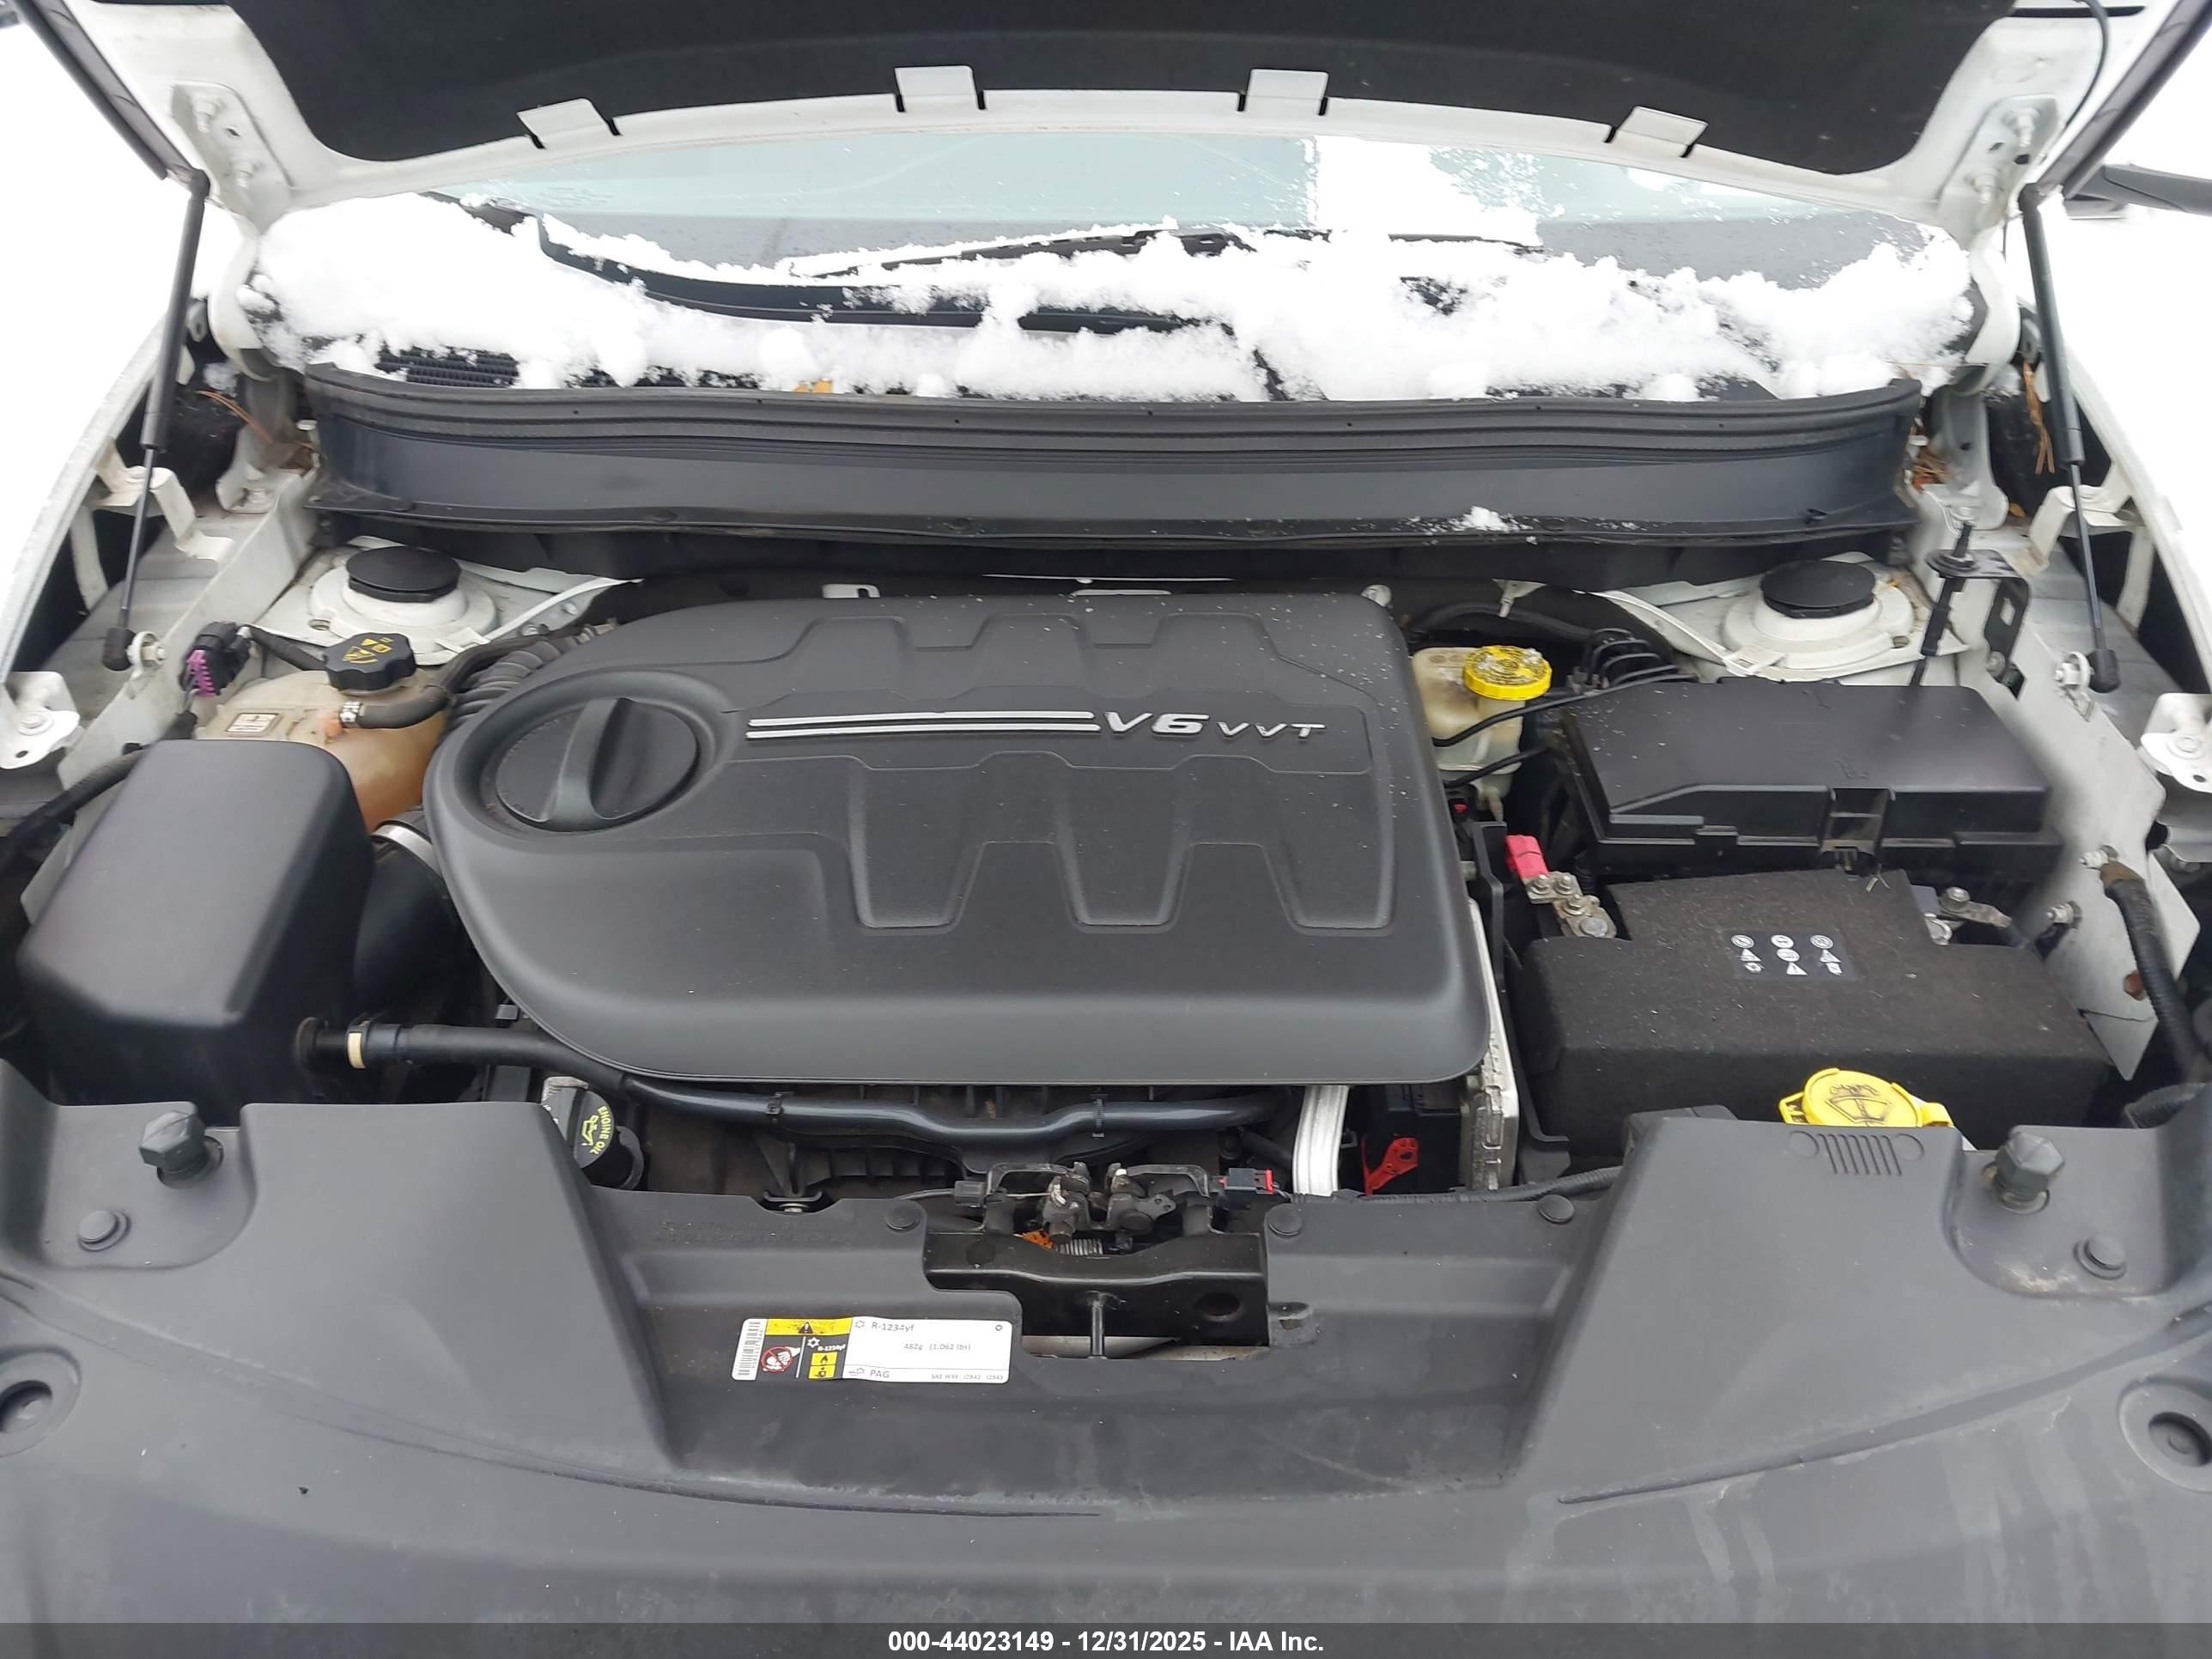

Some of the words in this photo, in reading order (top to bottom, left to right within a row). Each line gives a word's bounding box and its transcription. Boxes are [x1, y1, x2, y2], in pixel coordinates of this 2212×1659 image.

[1104, 710, 1211, 734] V6
[1217, 721, 1326, 740] VVT
[597, 1106, 612, 1140] ENGINE
[589, 1140, 606, 1155] OIL
[871, 1321, 915, 1333] R-1234yf
[869, 1369, 890, 1379] PAG
